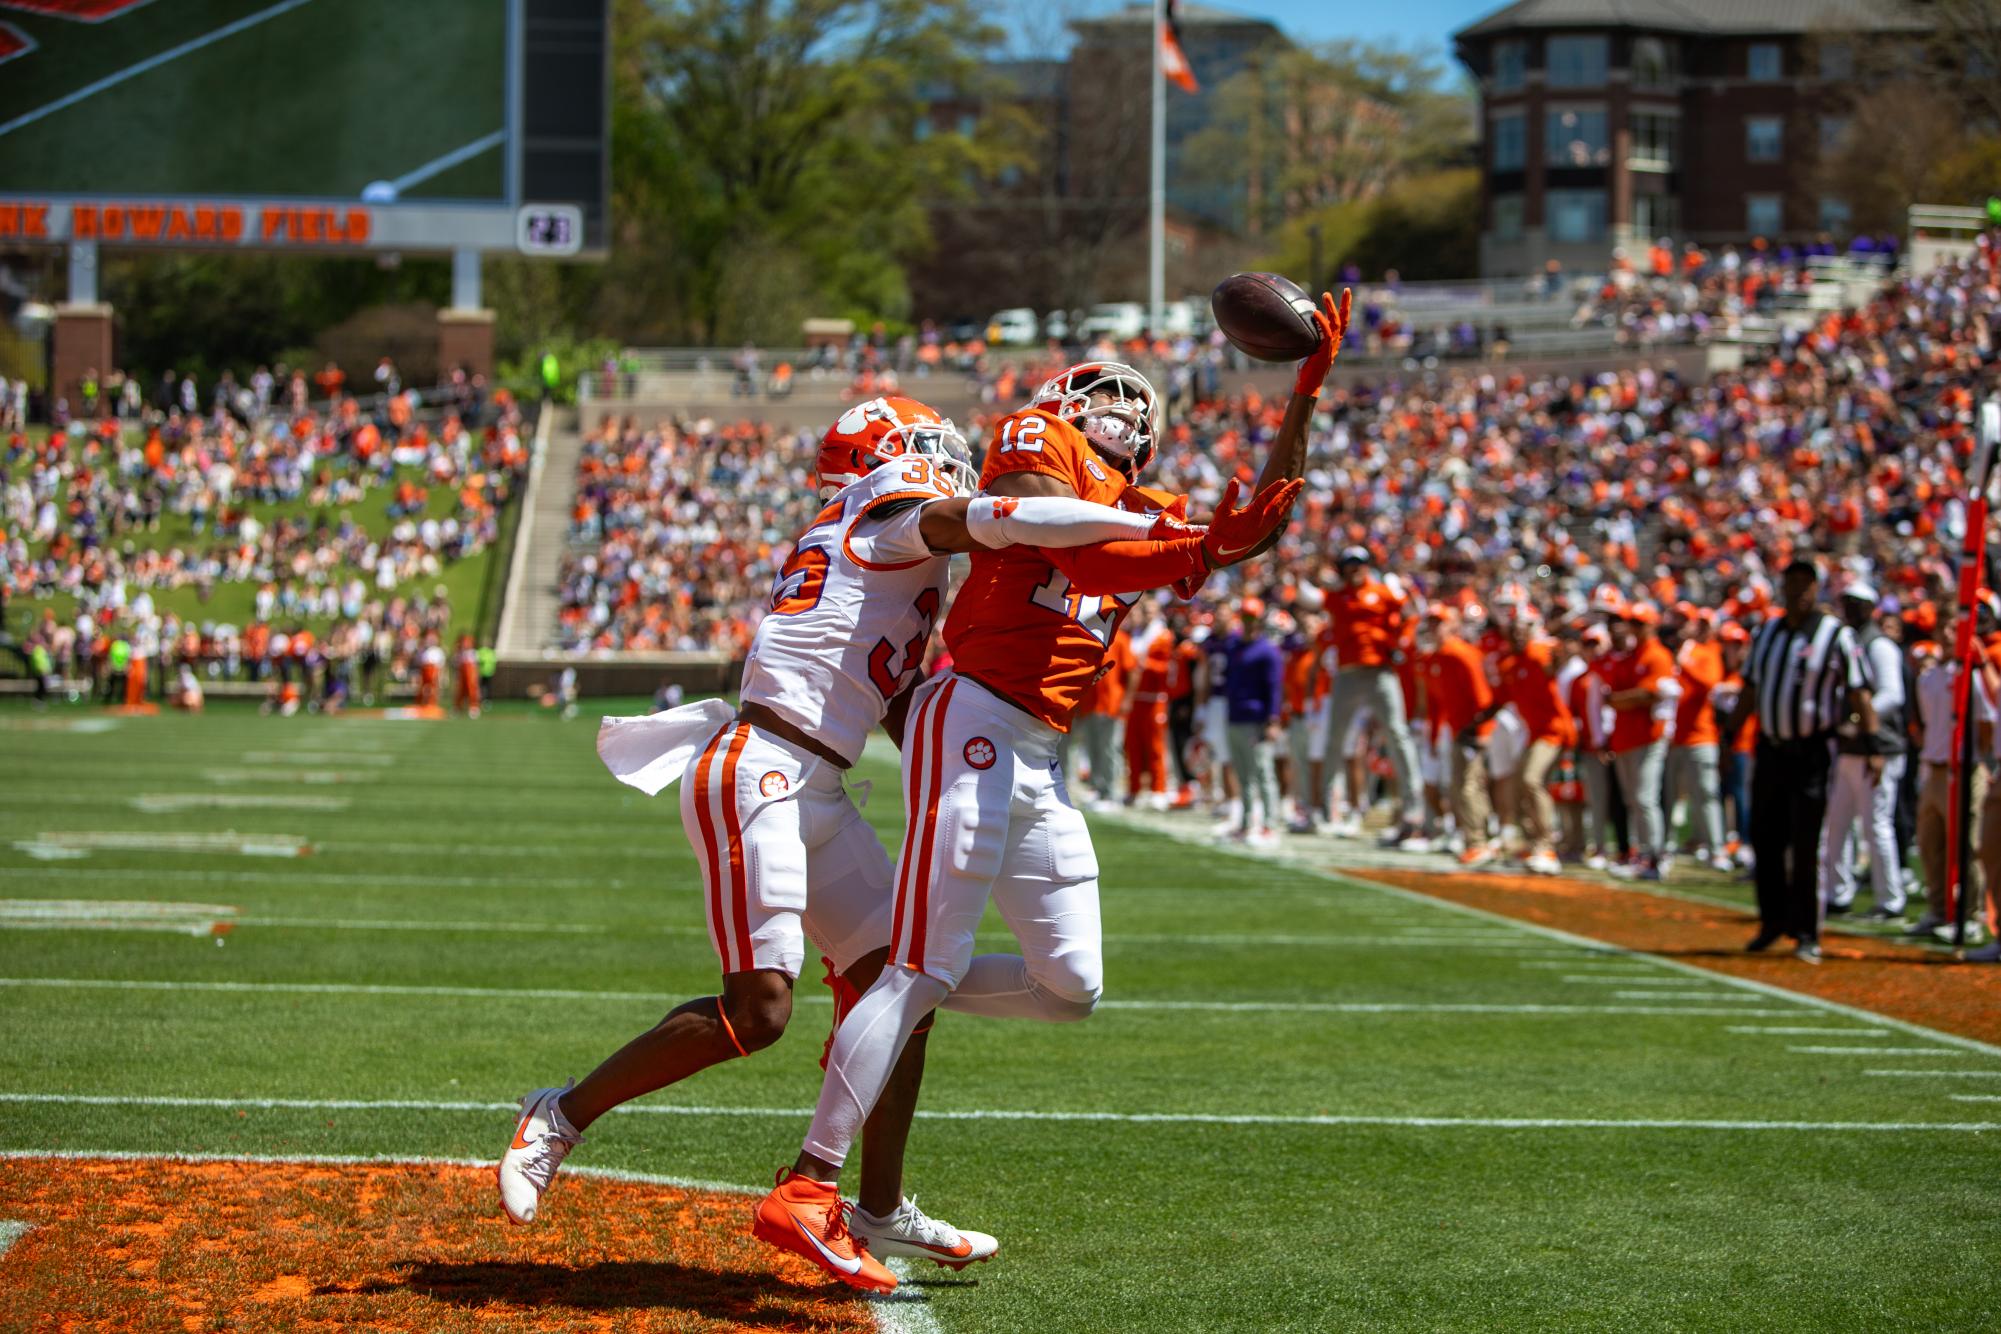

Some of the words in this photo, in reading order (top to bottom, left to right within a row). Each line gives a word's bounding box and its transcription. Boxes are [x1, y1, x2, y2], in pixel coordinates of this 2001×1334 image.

[73, 206, 243, 240] HOWARD
[262, 208, 371, 242] FIELD
[1000, 416, 1047, 454] 12
